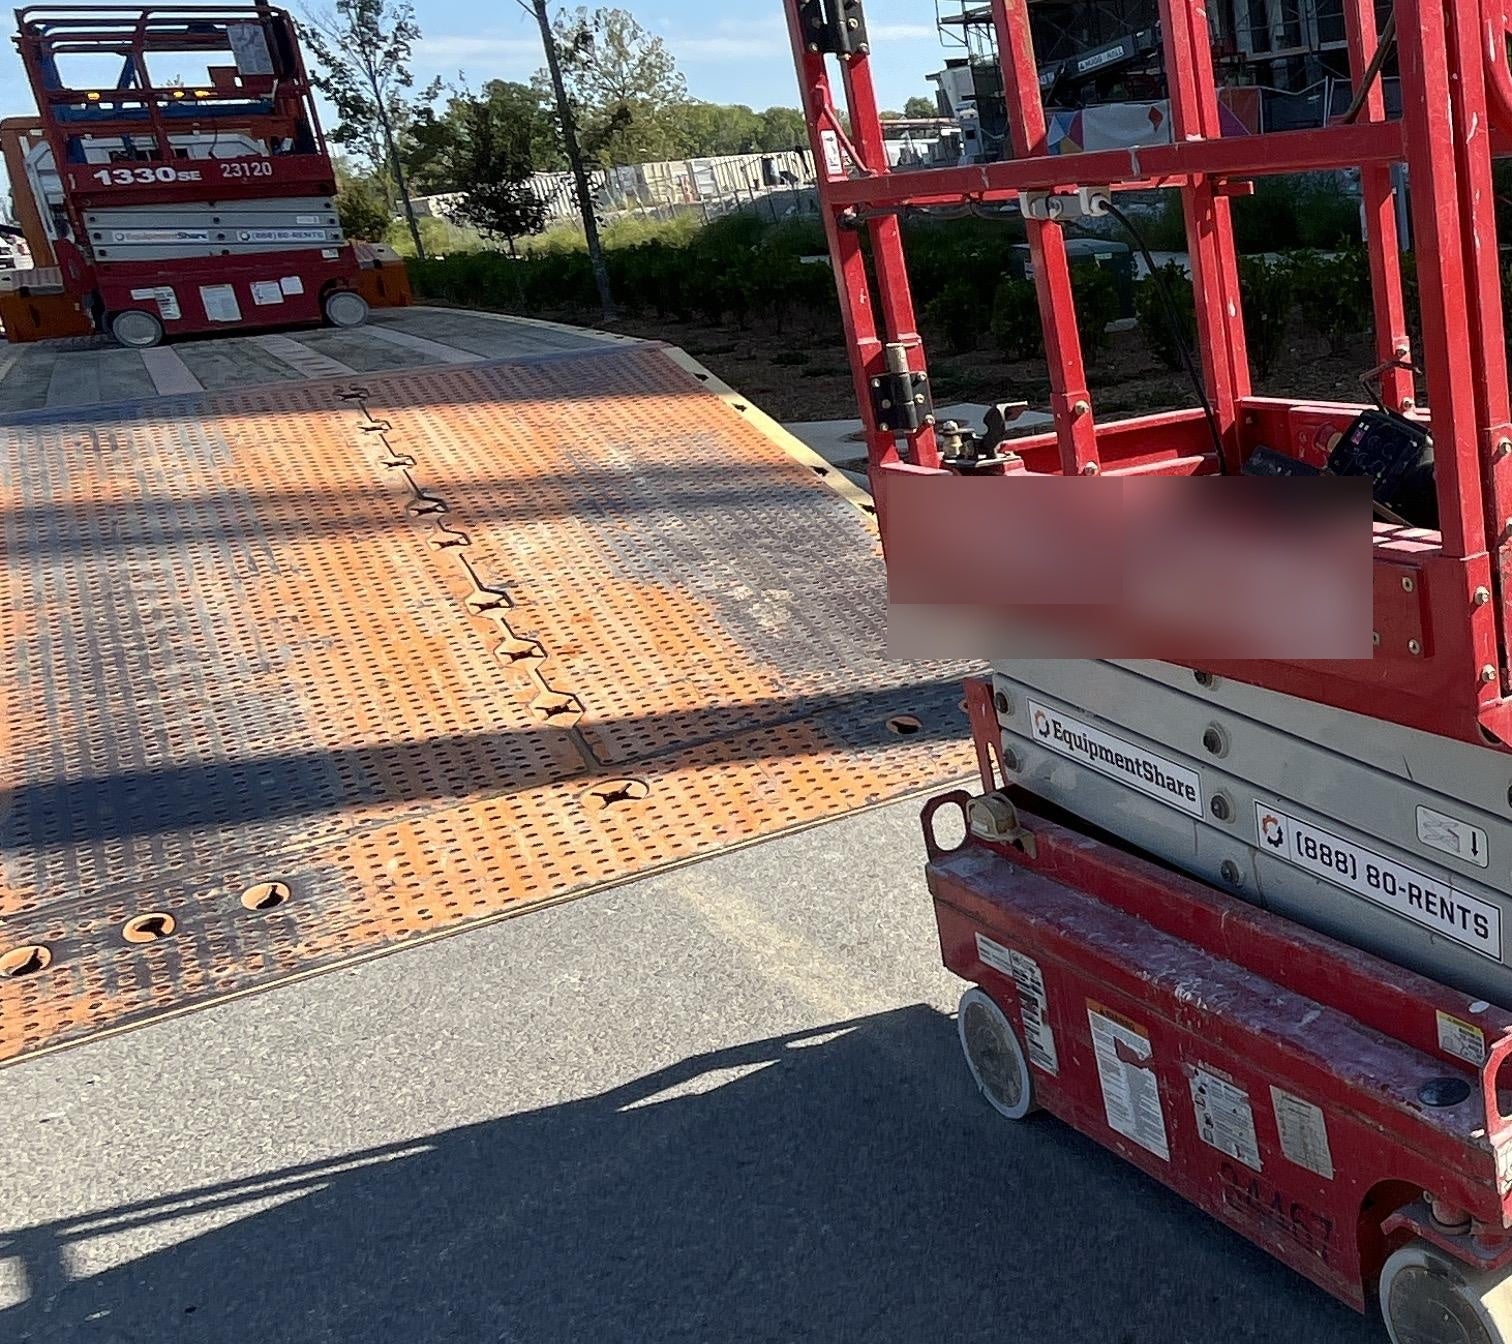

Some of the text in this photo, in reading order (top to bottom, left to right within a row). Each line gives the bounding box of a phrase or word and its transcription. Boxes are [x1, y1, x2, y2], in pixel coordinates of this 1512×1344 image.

[220, 161, 273, 178] 23120
[1051, 718, 1197, 802] EquipmentShare
[1296, 830, 1489, 940] (888) 80-RENTS
